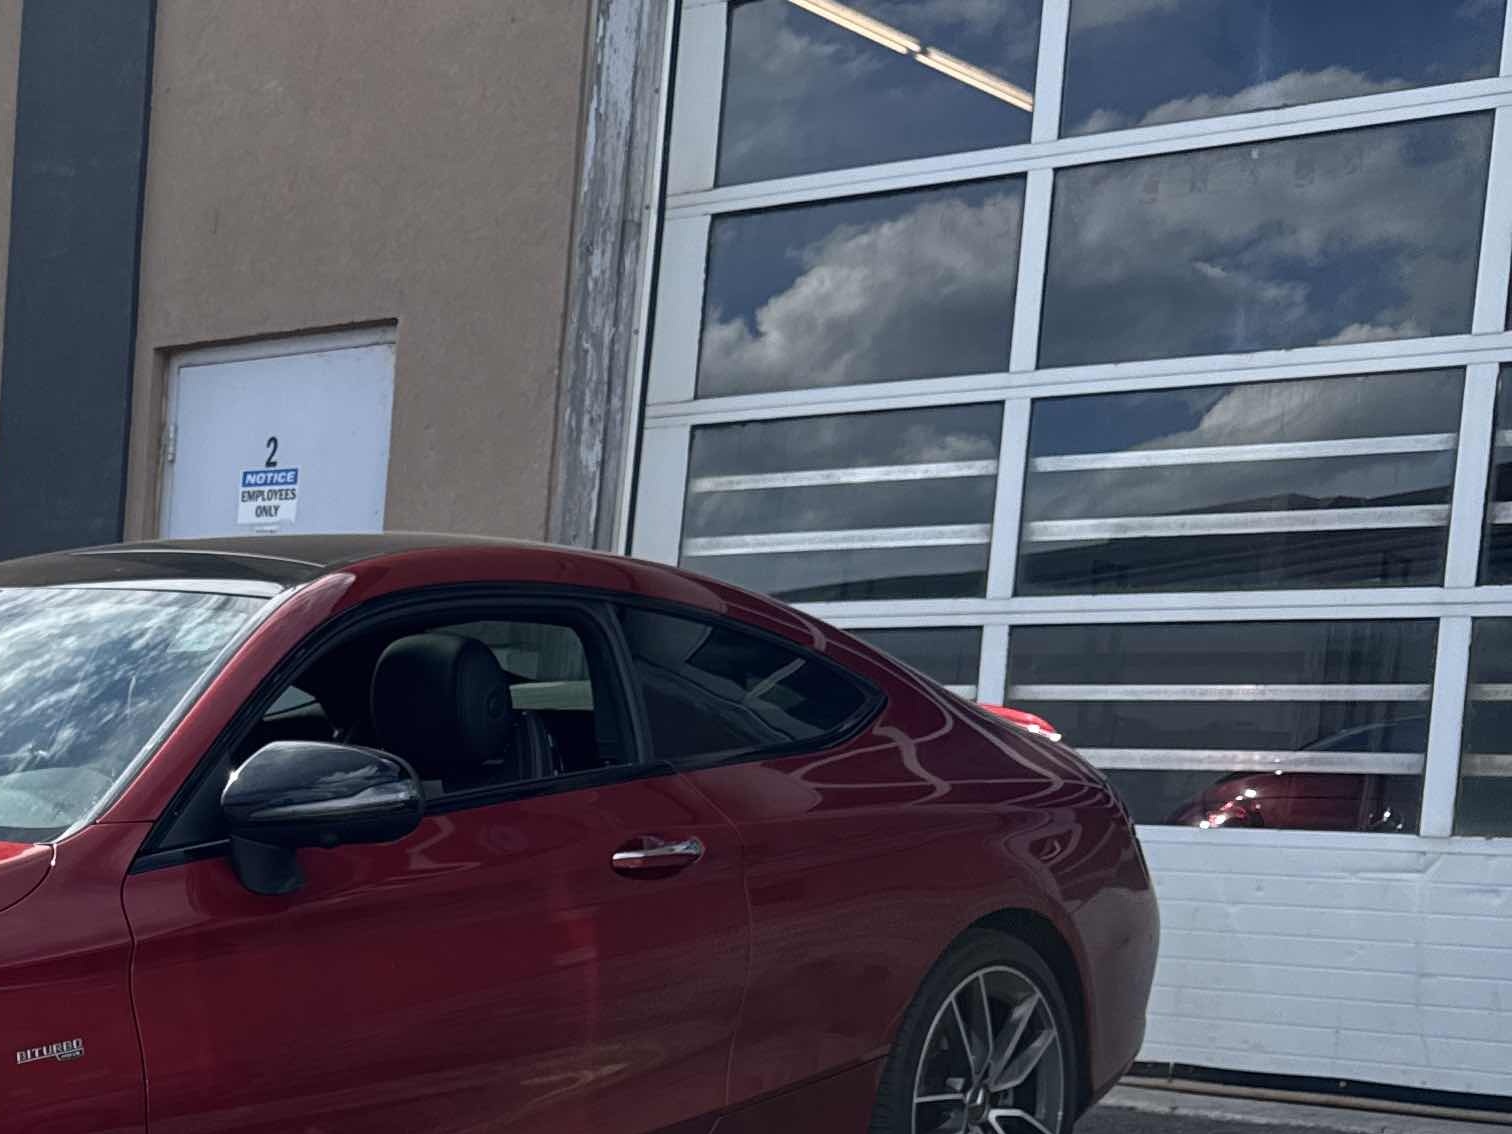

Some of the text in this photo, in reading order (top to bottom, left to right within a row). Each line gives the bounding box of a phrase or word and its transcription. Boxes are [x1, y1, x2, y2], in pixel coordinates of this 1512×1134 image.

[265, 436, 278, 468] 2
[245, 471, 295, 485] NOTICE
[241, 488, 297, 503] EMPLOYEES
[255, 504, 280, 518] ONLY
[16, 1038, 83, 1064] BITURBO
